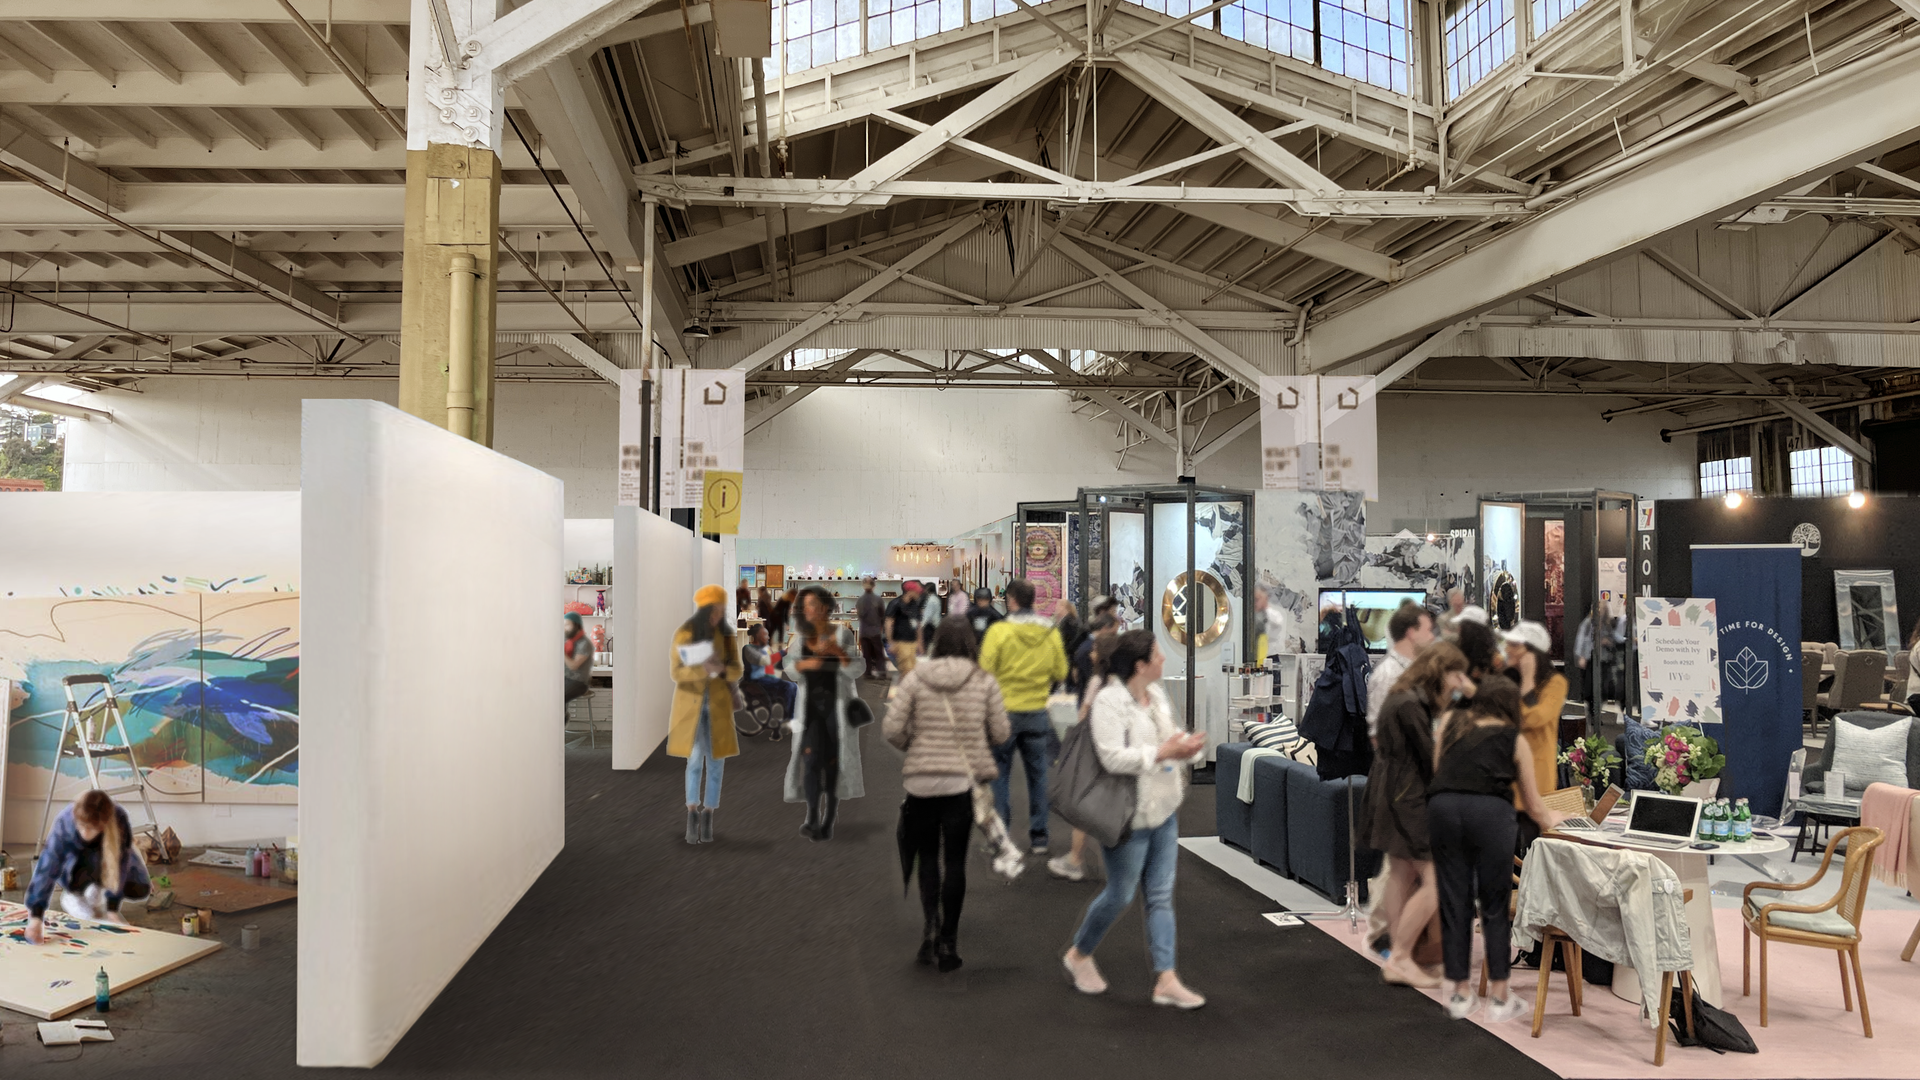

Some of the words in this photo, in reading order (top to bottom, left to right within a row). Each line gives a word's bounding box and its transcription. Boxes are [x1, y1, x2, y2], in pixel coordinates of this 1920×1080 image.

[1685, 638, 1700, 646] Your
[1719, 621, 1741, 635] TIME
[1745, 620, 1765, 631] FOR
[1767, 627, 1793, 661] DESIGN
[1691, 647, 1701, 655] Ivy
[1669, 672, 1684, 681] IVY
